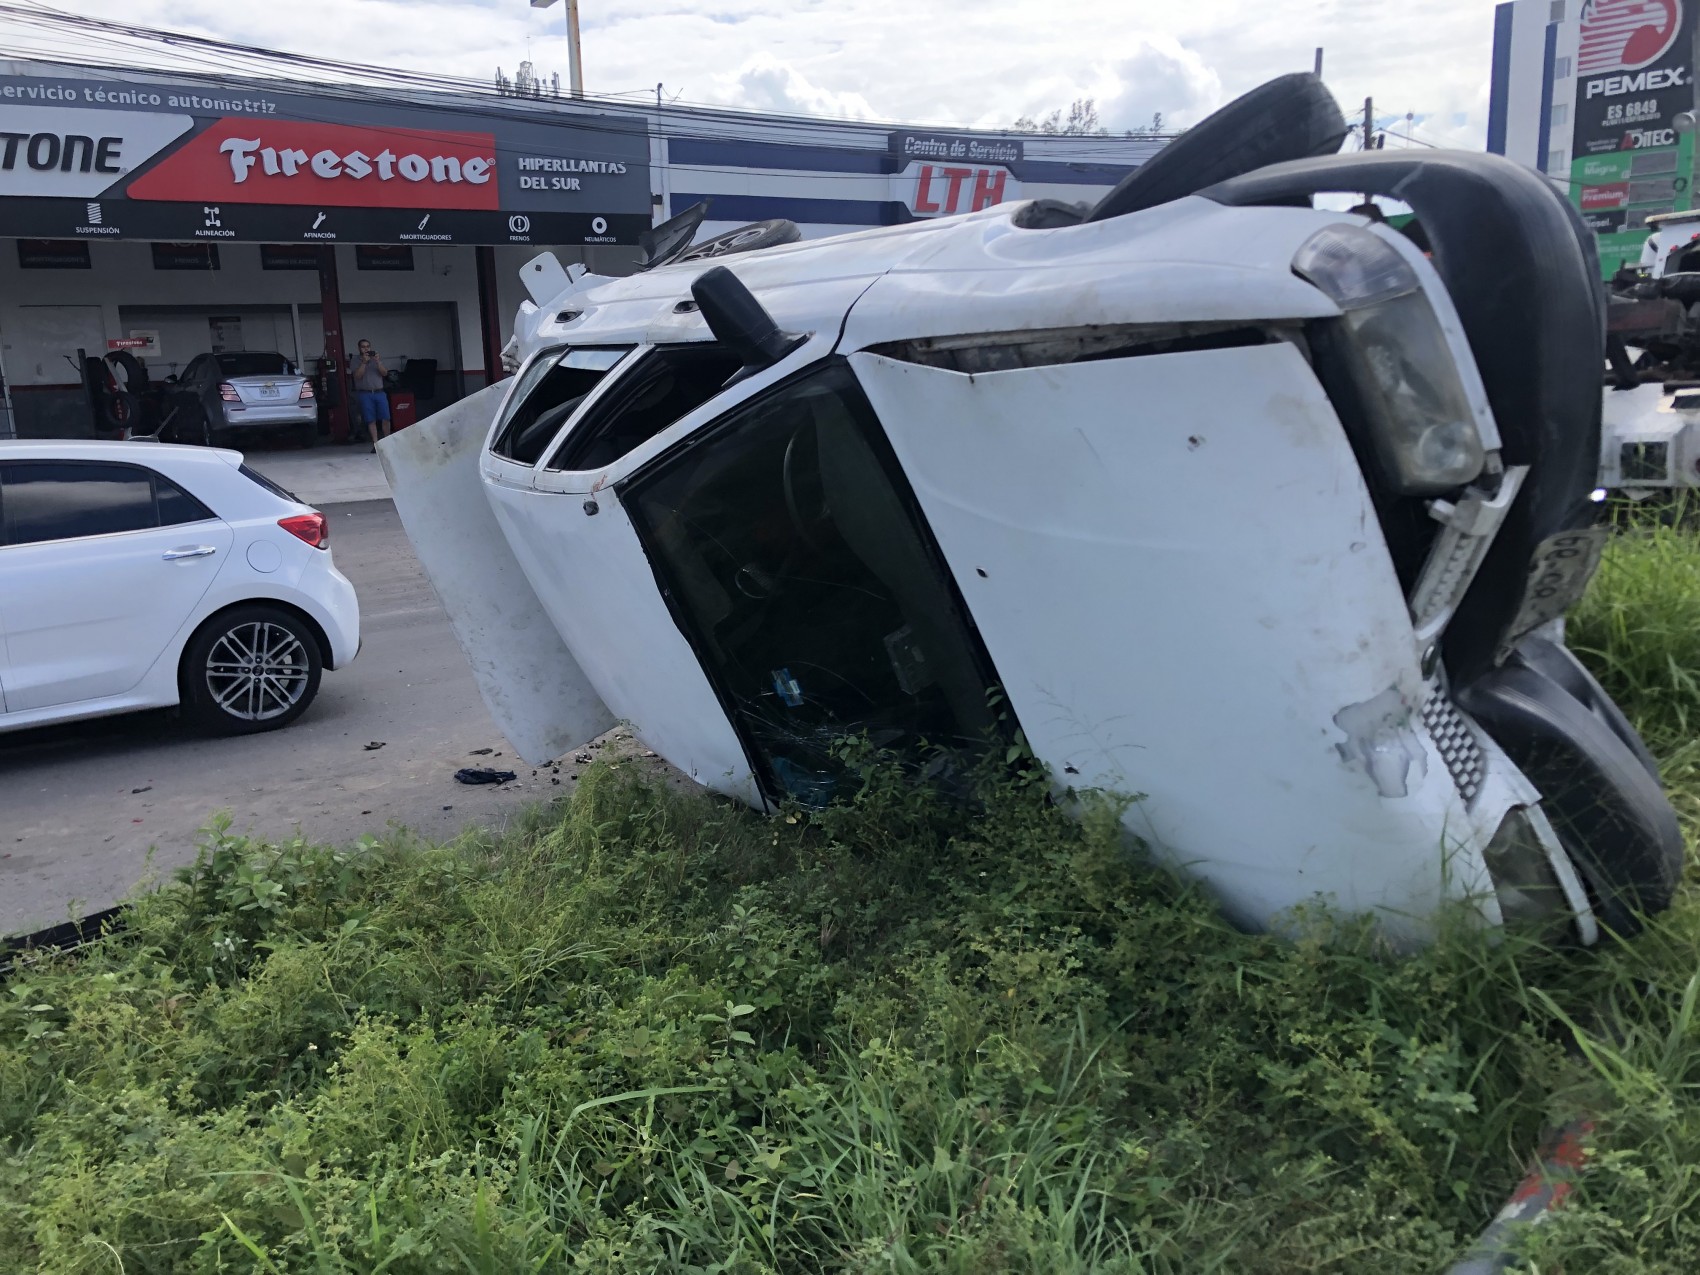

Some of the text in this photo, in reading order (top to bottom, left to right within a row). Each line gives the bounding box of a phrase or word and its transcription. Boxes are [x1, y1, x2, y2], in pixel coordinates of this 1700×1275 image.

[1586, 67, 1685, 99] PEMEX
[0, 84, 276, 114] ervicio técnico automotriz
[1607, 104, 1623, 120] ES
[1626, 99, 1658, 117] 6849
[904, 136, 1018, 161] Centro de Servicio
[219, 137, 491, 184] Firestone
[518, 157, 627, 175] HIPERLLANTAS
[520, 176, 581, 191] DEL SUR
[914, 165, 1007, 213] LTH
[1582, 191, 1624, 202] Premium
[75, 226, 120, 235] SUSPENSIÓN
[195, 228, 235, 237] ALINEACIÓN
[303, 231, 336, 239] AFINACIÓN
[399, 233, 452, 241] AMORTIGUADORES
[584, 235, 617, 243] NEUMÁTICOS
